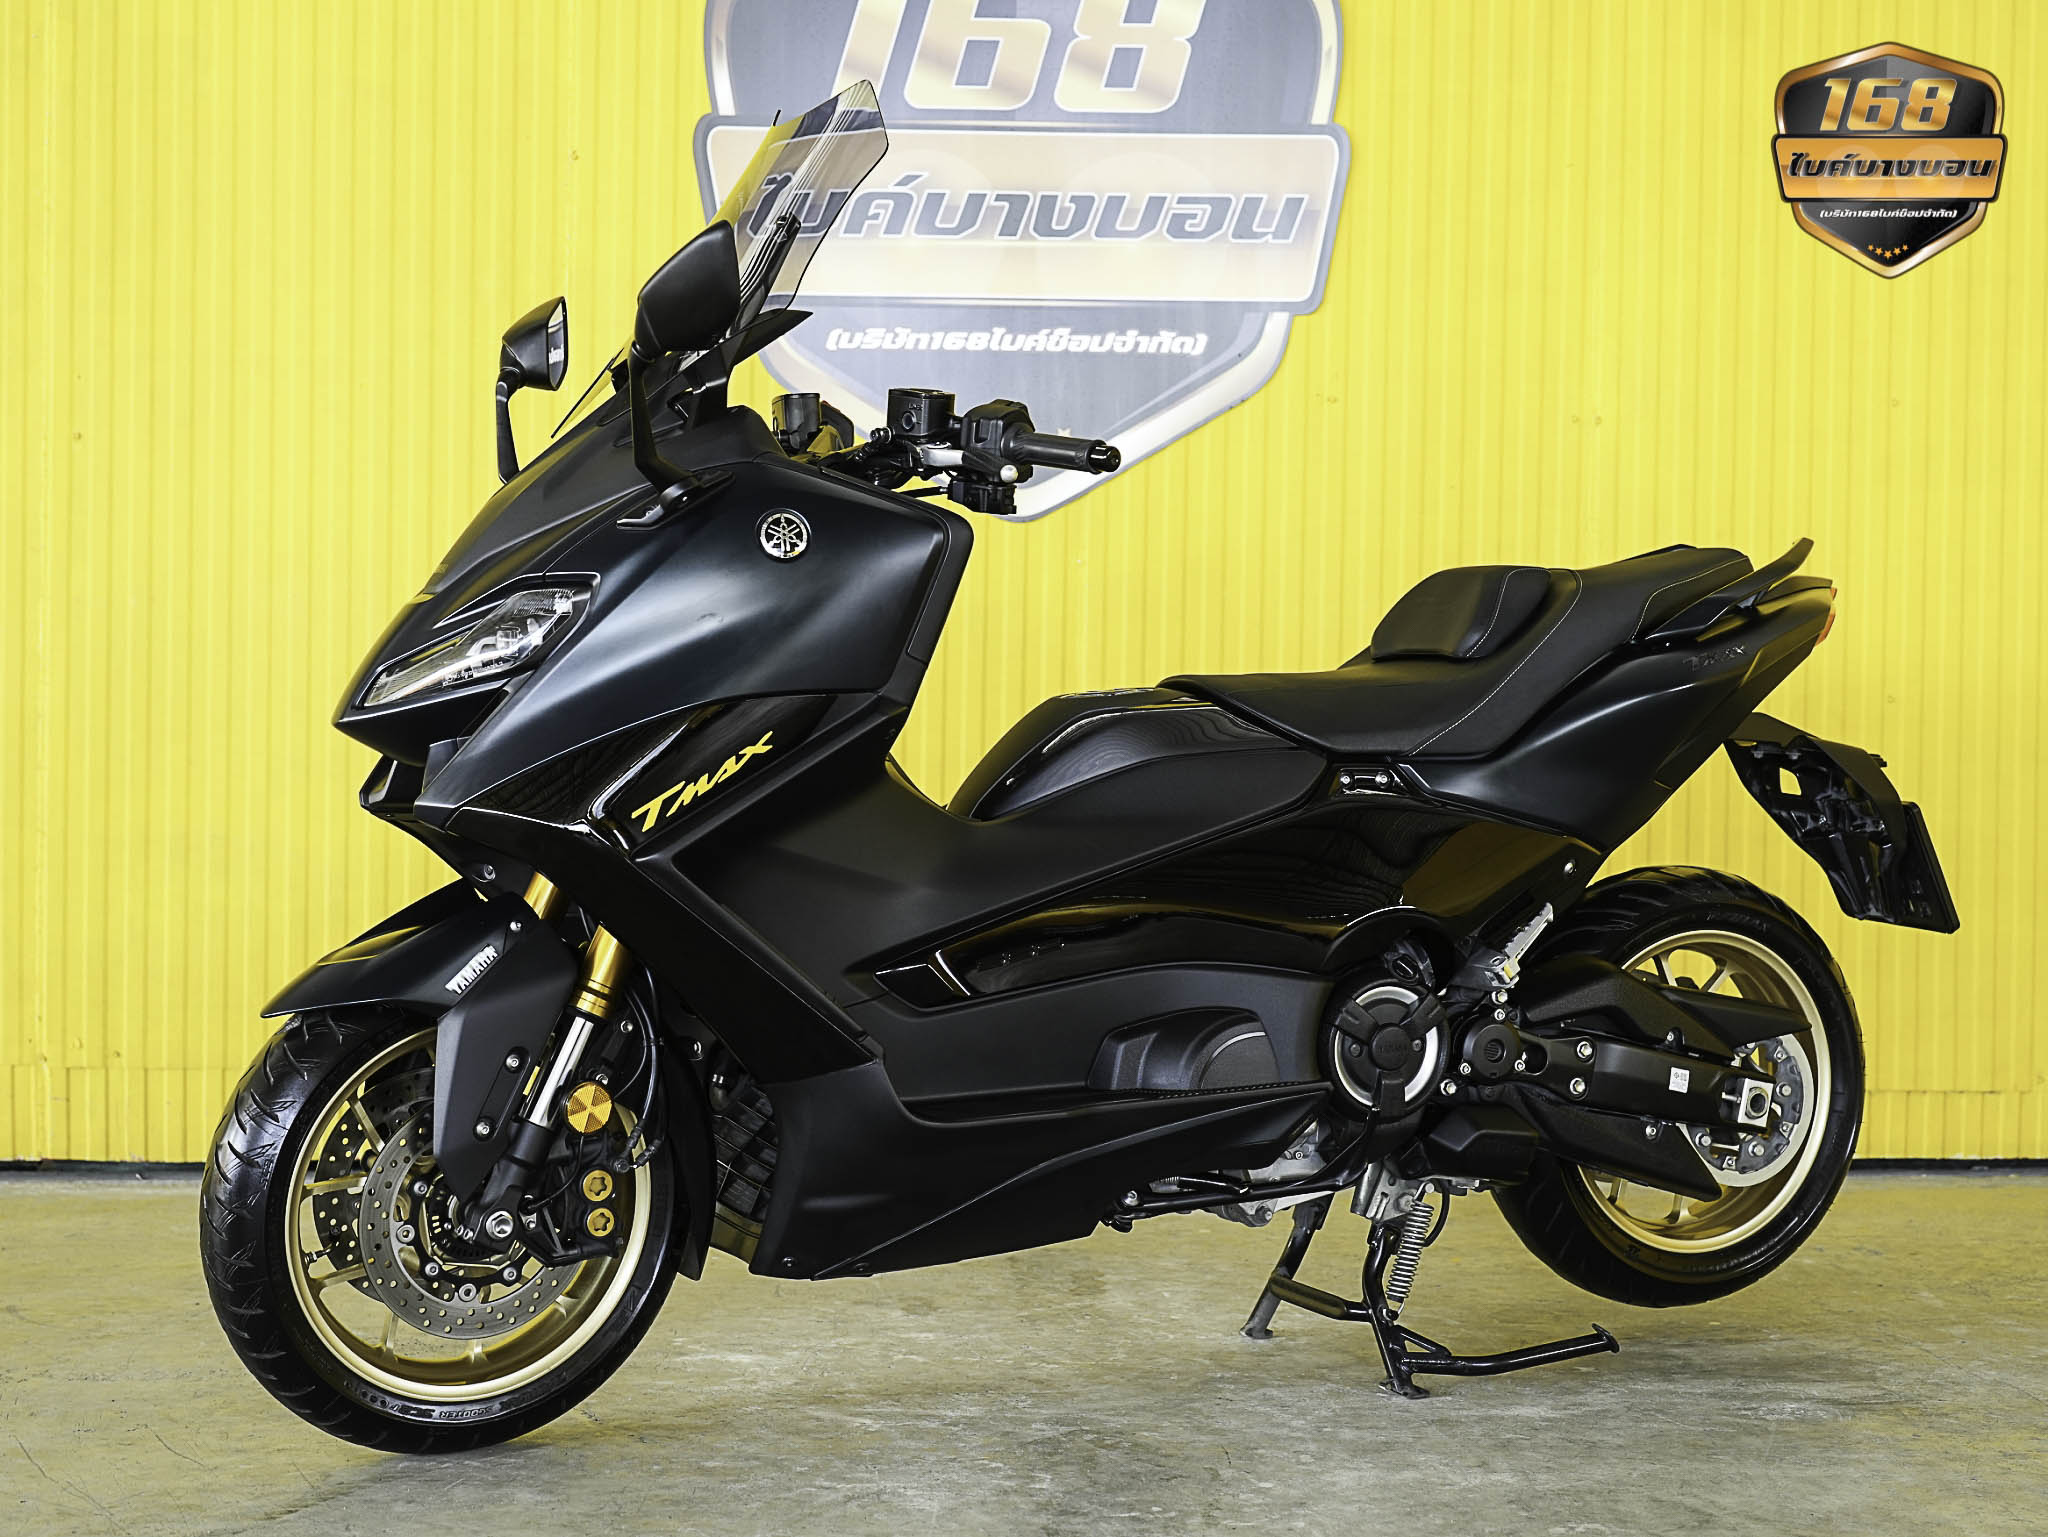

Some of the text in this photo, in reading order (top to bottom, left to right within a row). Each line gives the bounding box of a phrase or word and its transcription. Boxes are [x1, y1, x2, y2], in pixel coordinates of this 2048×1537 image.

[828, 0, 1204, 113] 168
[747, 171, 1308, 242] ไบค์บางบอน
[631, 731, 773, 832] TMAX
[444, 945, 498, 995] YAMAHA
[439, 1406, 491, 1419] SCOOTER
